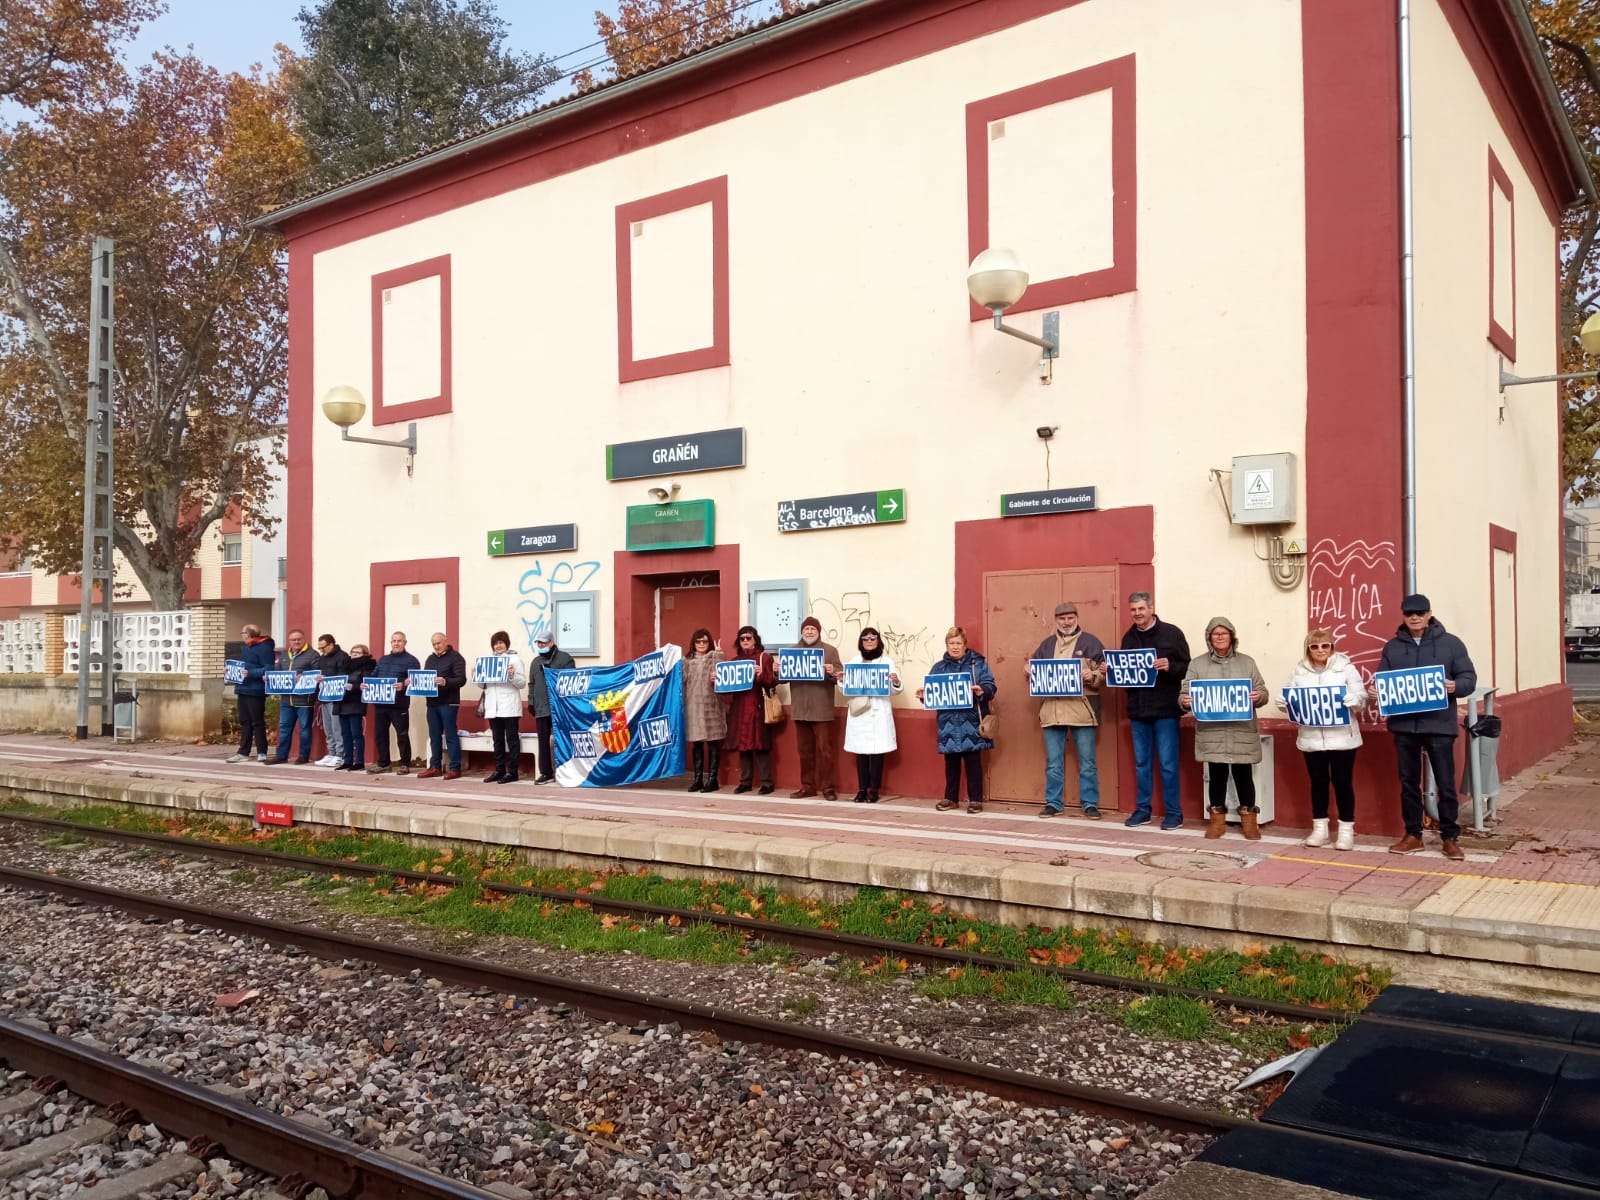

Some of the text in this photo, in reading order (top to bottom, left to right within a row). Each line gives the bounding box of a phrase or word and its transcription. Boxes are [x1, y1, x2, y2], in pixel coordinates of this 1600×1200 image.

[652, 442, 699, 464] GRAÑÉN
[800, 505, 853, 520] Barcelona
[1008, 494, 1091, 509] Gabinete de Circulación
[521, 535, 557, 547] Zaragoza
[780, 650, 823, 678] GRAÑÉN
[1106, 652, 1155, 669] ALBERO
[268, 674, 293, 689] TORRES
[716, 664, 754, 686] SODETO
[845, 669, 889, 689] ALMUNIENTE
[1031, 664, 1080, 693] SANGARREN
[1114, 669, 1148, 684] BAJO
[924, 676, 972, 707] GRAÑÉN
[1191, 685, 1250, 713] TRAMACED
[1378, 672, 1446, 707] BARBUES
[1288, 688, 1344, 725] CURBE
